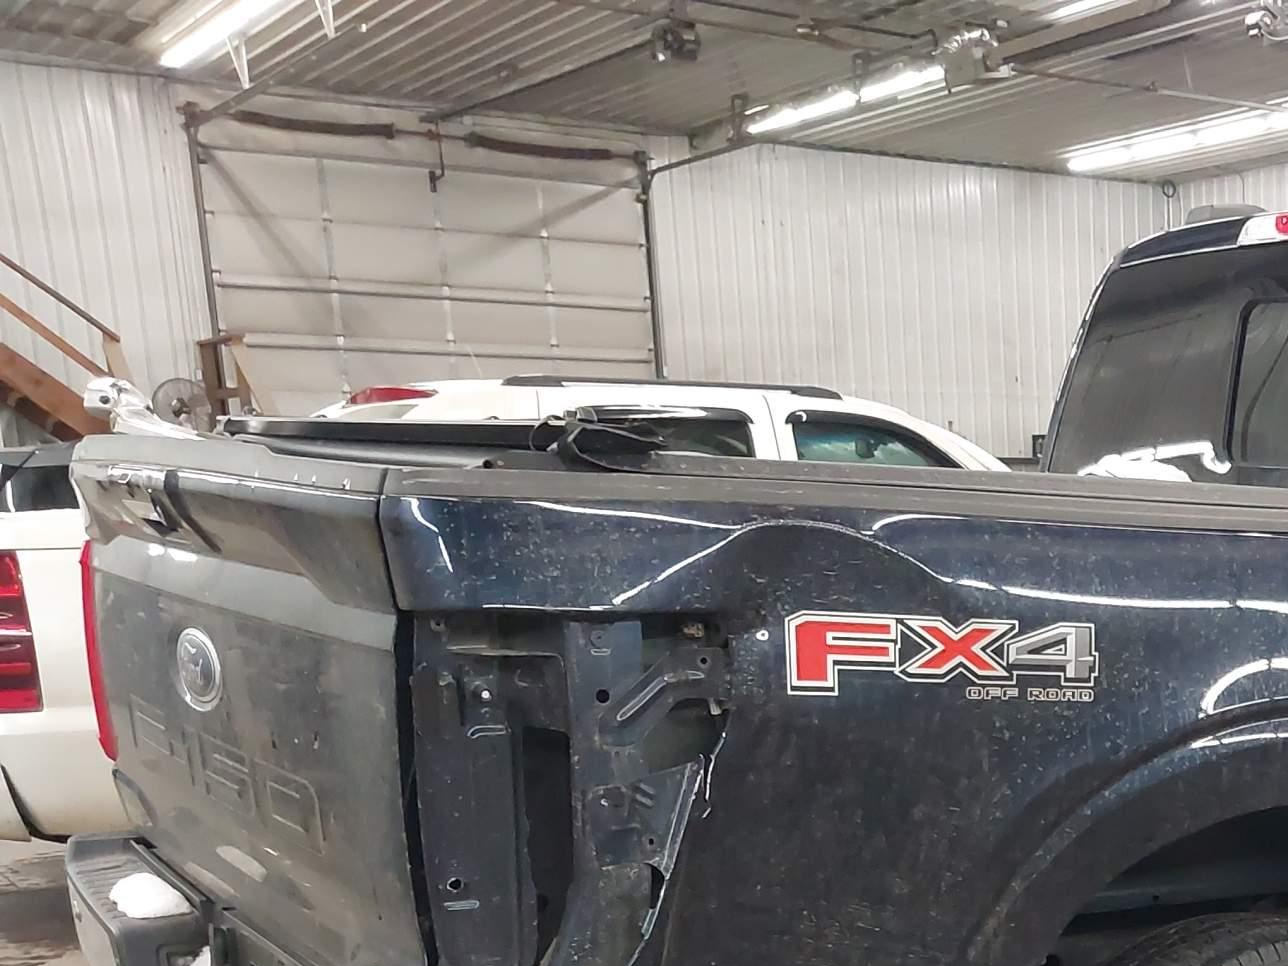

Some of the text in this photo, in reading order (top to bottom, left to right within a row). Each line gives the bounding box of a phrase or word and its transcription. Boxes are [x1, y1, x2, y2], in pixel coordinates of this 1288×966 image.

[785, 610, 1098, 696] FX4
[966, 686, 1094, 701] OFF ROAD
